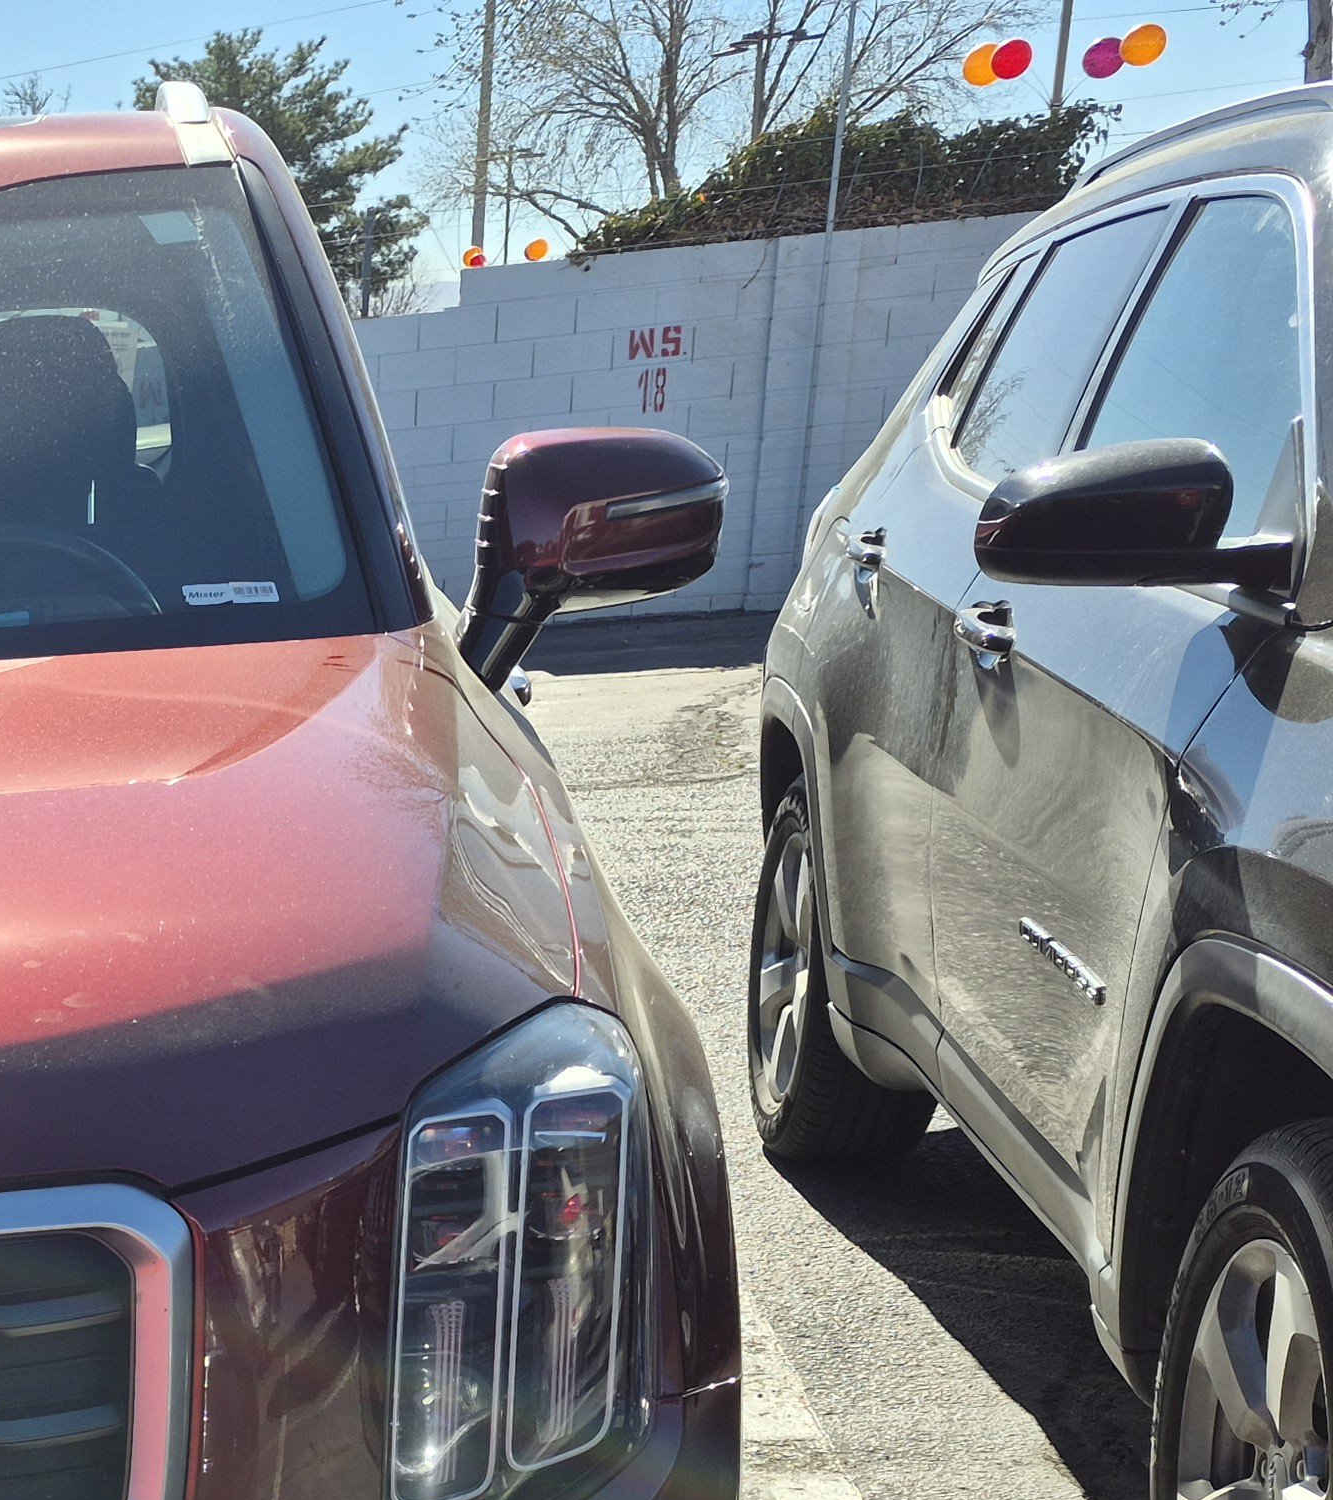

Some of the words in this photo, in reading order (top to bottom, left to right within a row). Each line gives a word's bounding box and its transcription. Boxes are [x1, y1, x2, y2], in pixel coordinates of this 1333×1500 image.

[628, 325, 688, 361] W.S.
[637, 367, 667, 414] 18
[187, 590, 227, 599] Mister
